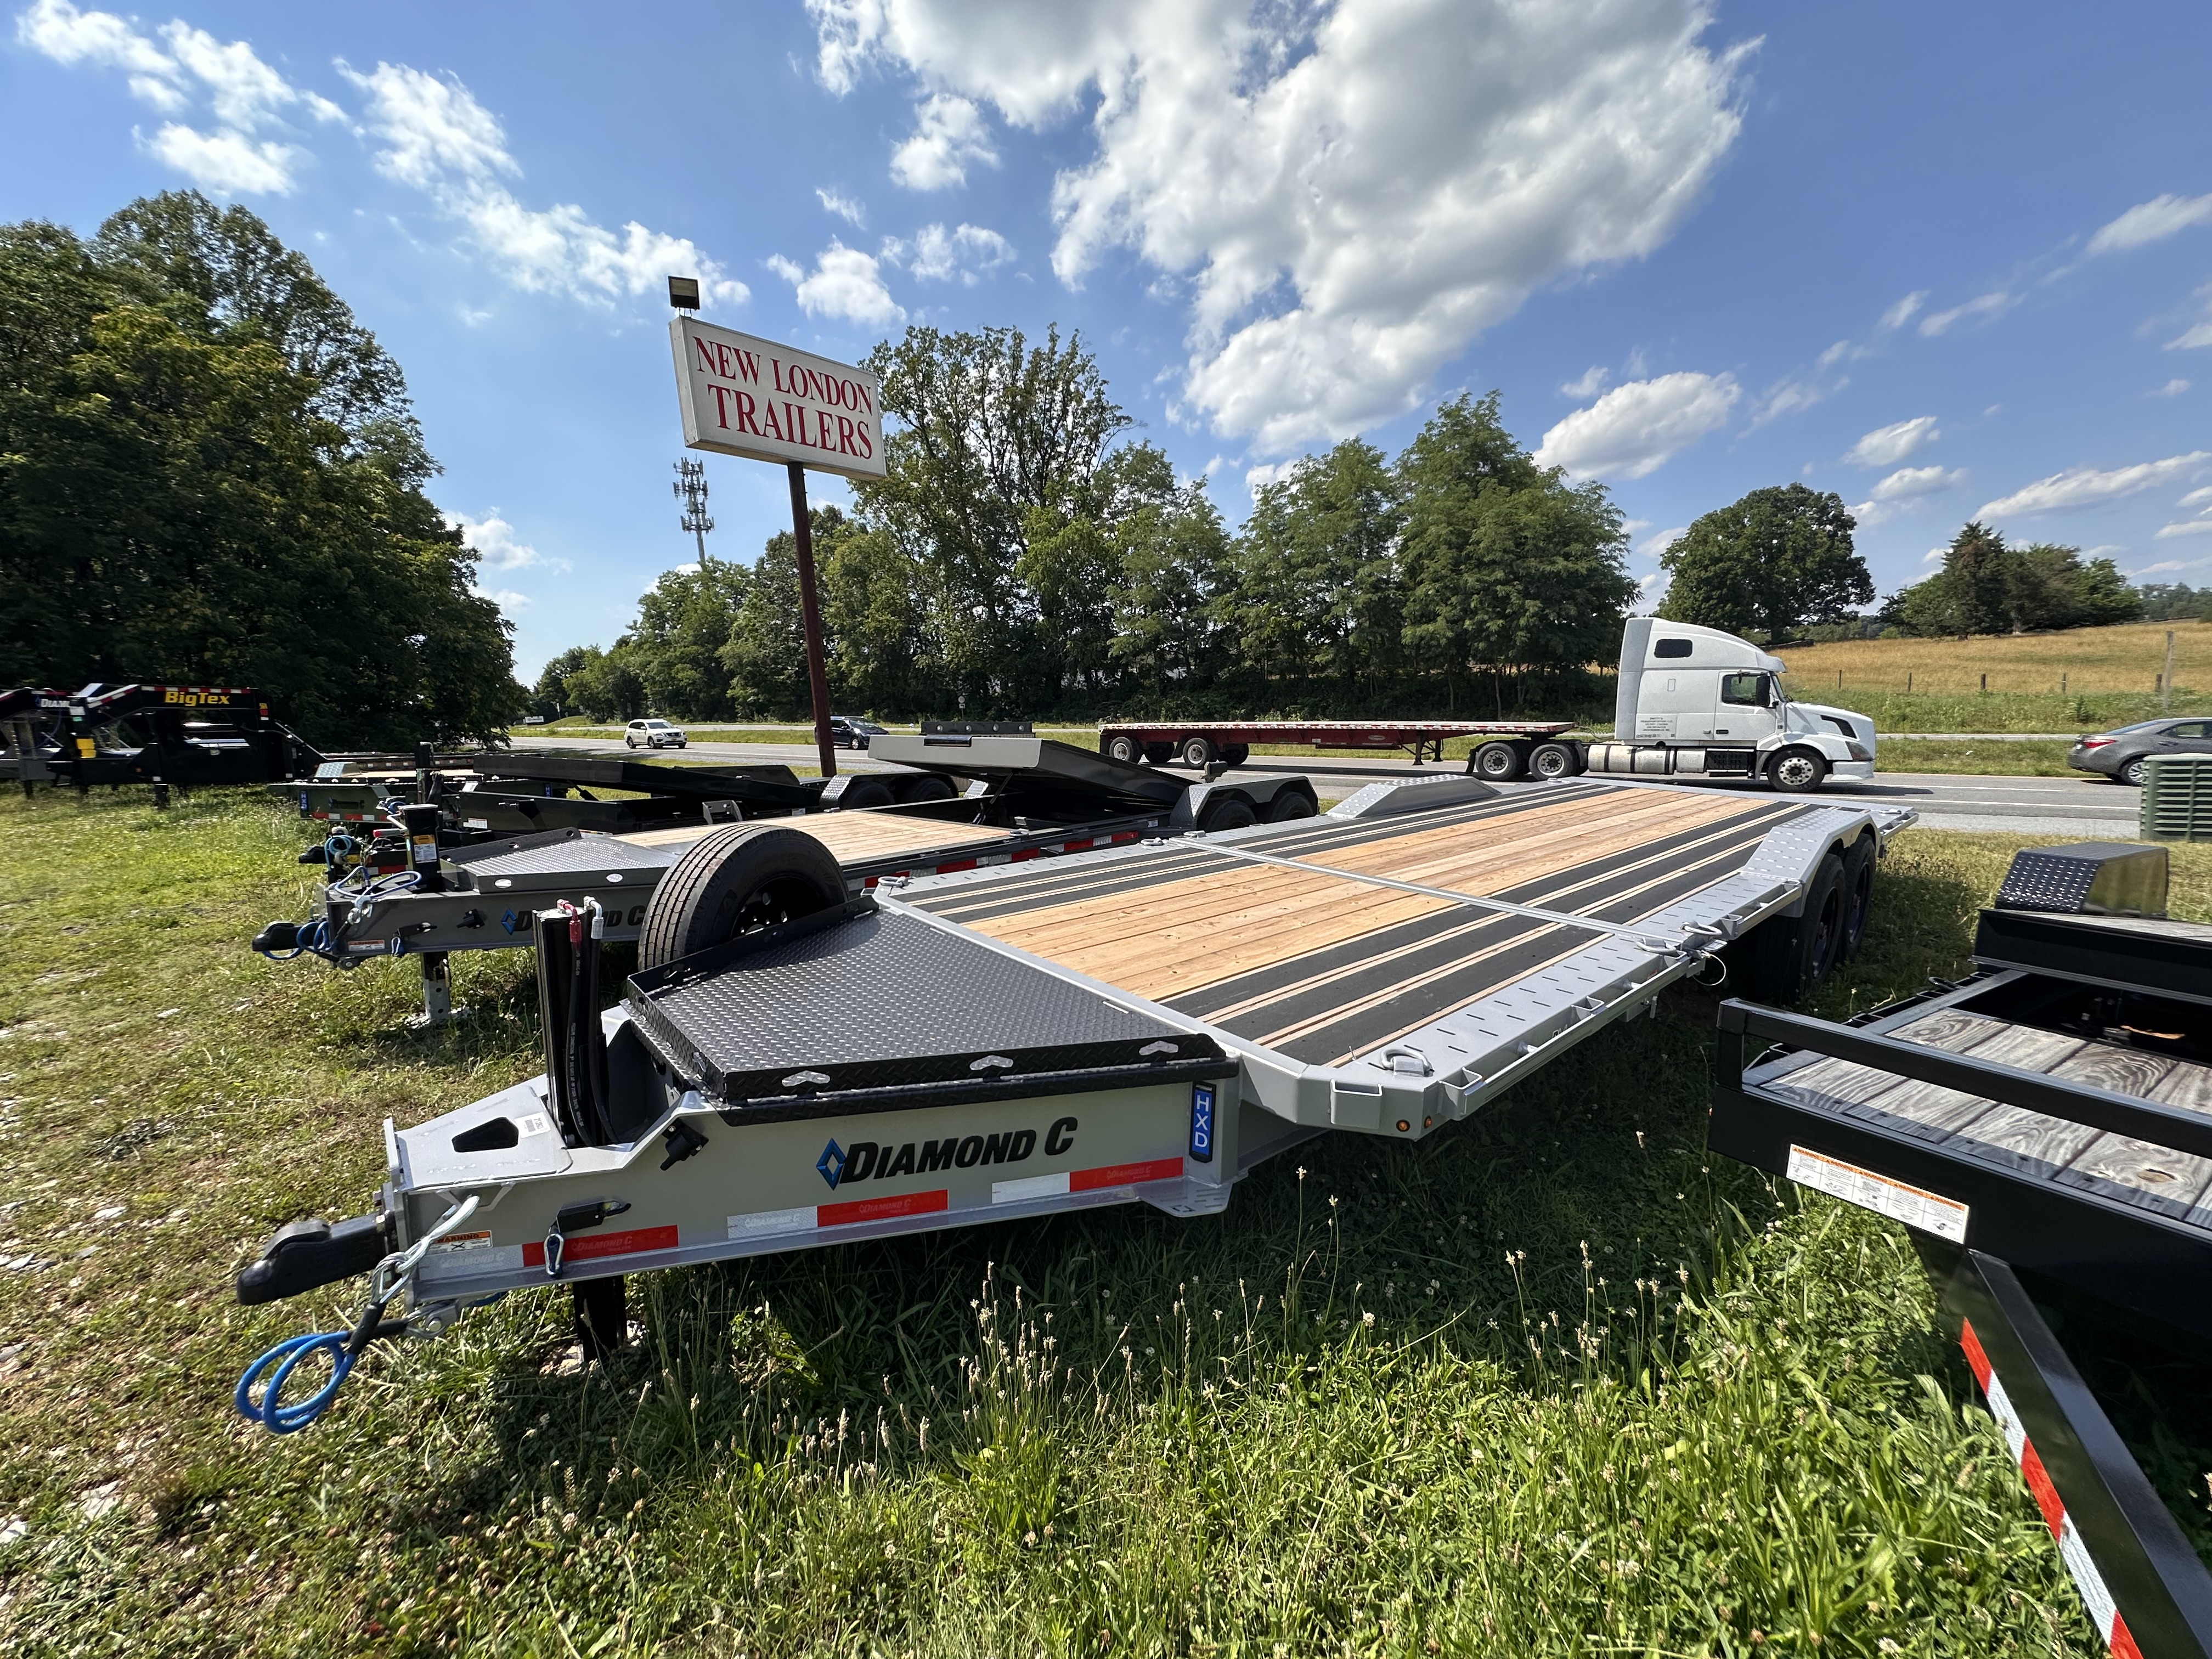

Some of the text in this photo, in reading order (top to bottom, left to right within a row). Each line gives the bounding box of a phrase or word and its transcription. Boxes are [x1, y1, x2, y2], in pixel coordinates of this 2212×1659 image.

[693, 336, 873, 416] NEW LONDON
[707, 383, 873, 459] TRAILERS
[165, 691, 230, 707] BigTex
[1194, 1094, 1210, 1148] HXD
[839, 1117, 1078, 1184] DIAMOND C
[437, 1233, 479, 1244] WARNING
[577, 1238, 623, 1251] DIAMOND
